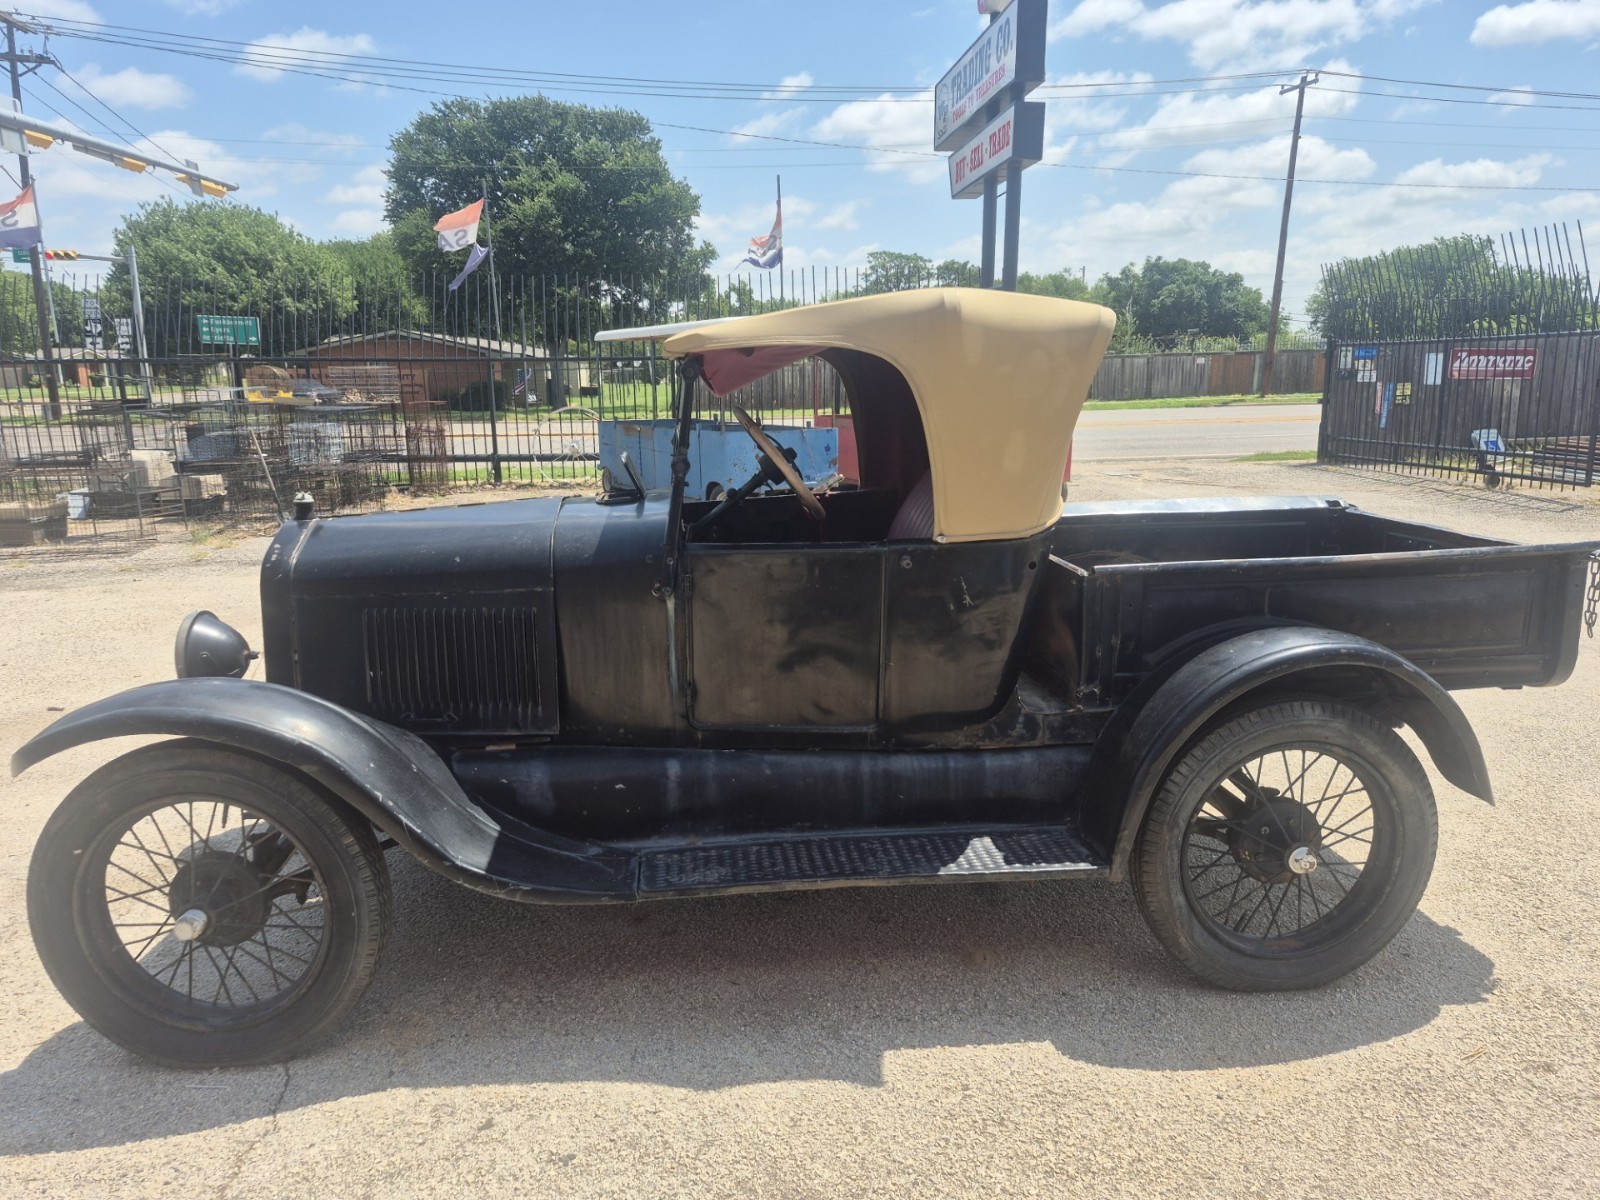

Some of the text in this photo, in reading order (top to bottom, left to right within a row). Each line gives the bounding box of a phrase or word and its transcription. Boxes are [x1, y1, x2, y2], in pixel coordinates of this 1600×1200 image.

[951, 17, 1013, 108] TRADING CO.
[970, 142, 984, 173] SELL
[988, 120, 1011, 159] TRADE
